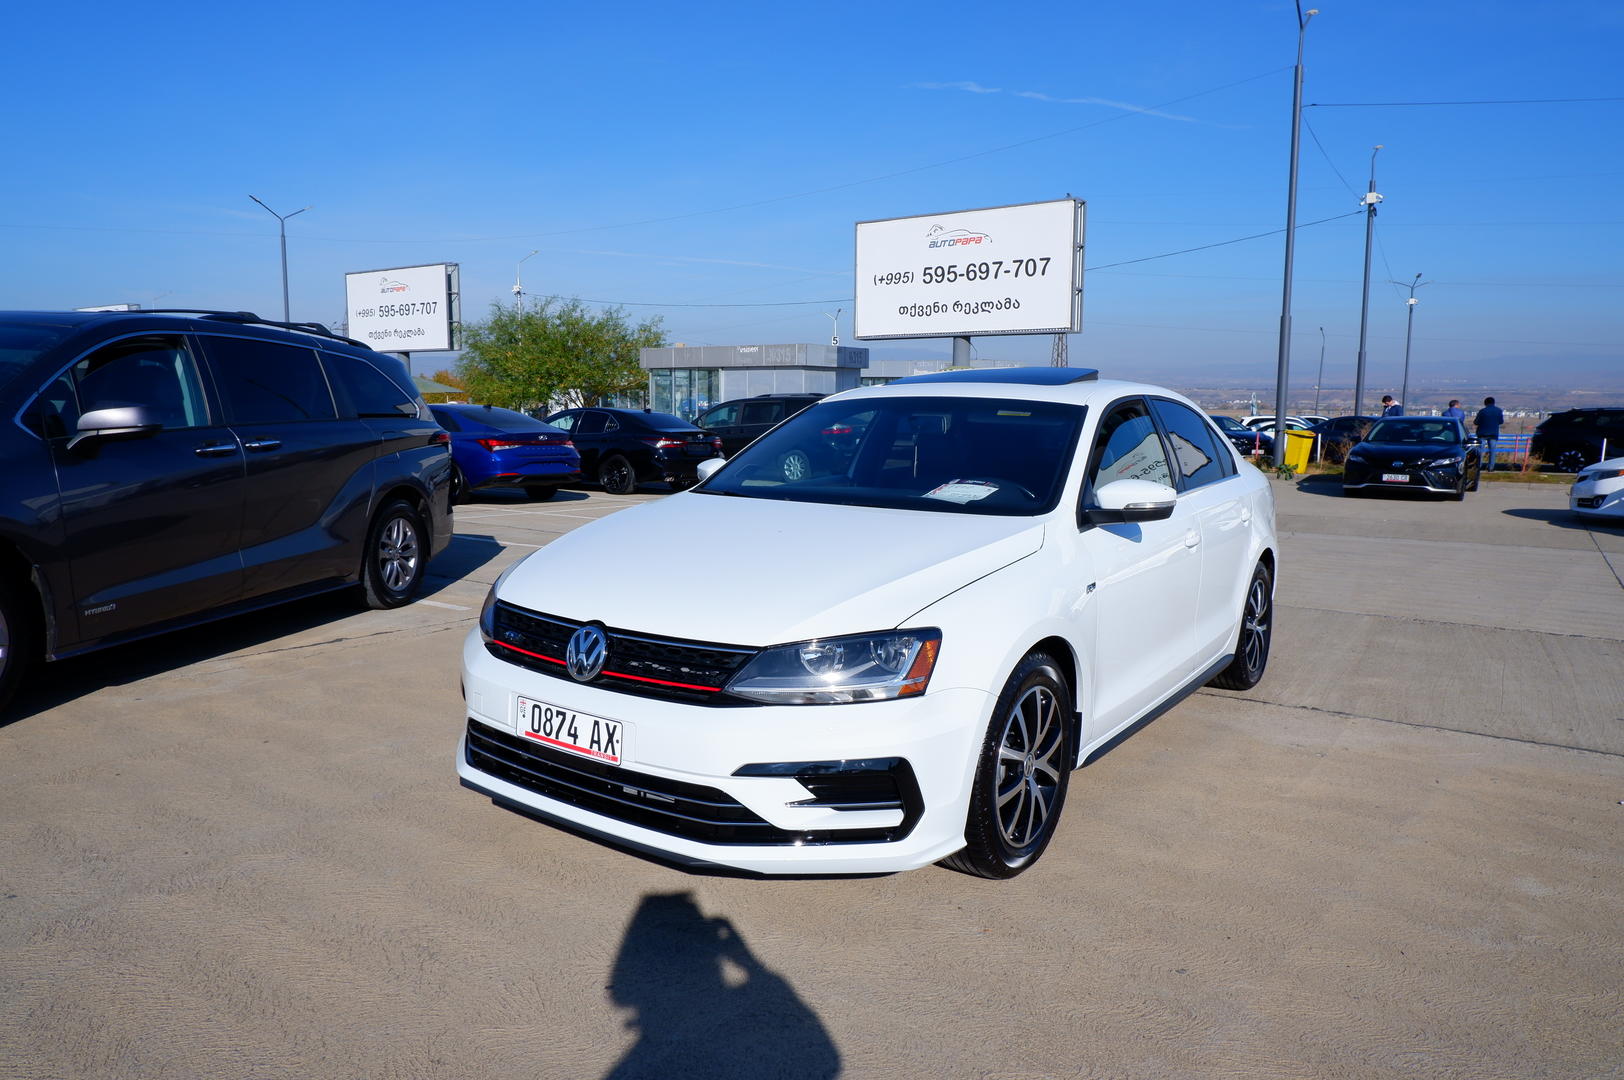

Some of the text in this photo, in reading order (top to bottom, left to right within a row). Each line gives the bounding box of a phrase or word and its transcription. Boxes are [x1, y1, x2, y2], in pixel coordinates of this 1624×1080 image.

[873, 257, 1051, 286] (+995) 595-697-707
[355, 301, 437, 318] (+995) 595-697-707
[898, 297, 1021, 317] თქვენი რეკლამა
[832, 336, 839, 346] 5
[530, 703, 618, 756] 0874 AX
